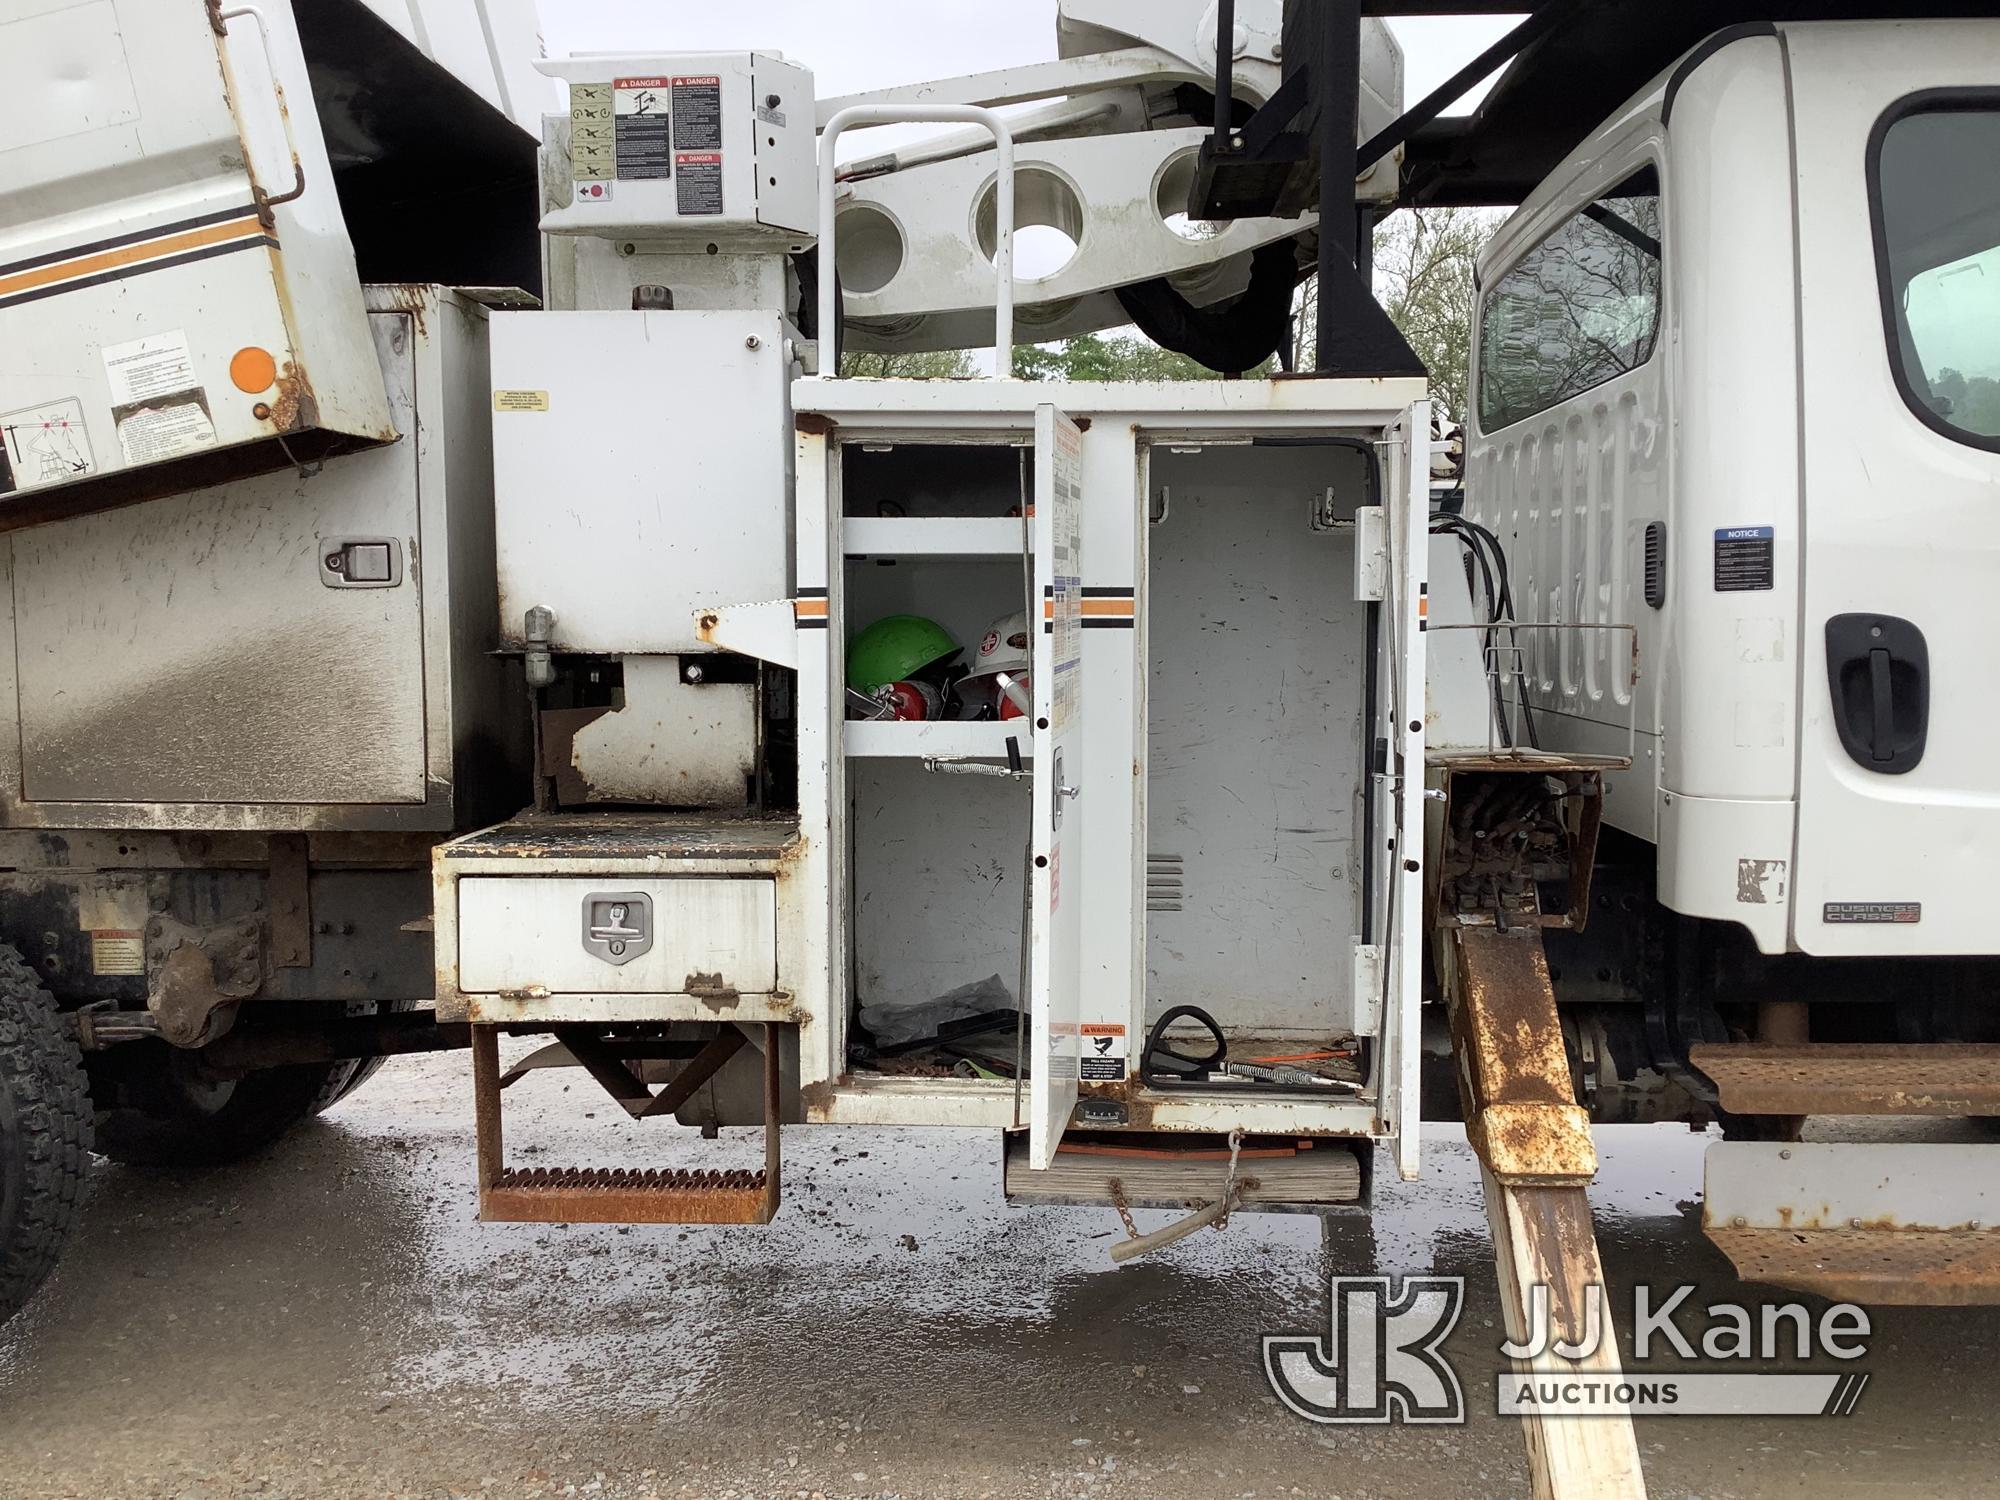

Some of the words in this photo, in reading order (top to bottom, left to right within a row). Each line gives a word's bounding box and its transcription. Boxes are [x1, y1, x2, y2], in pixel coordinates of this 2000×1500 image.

[630, 79, 661, 88] DANGER
[686, 77, 717, 86] DANGER
[1728, 529, 1759, 538] NOTICE
[1827, 905, 1919, 913] BUSINESS
[1826, 913, 1893, 921] CLASS
